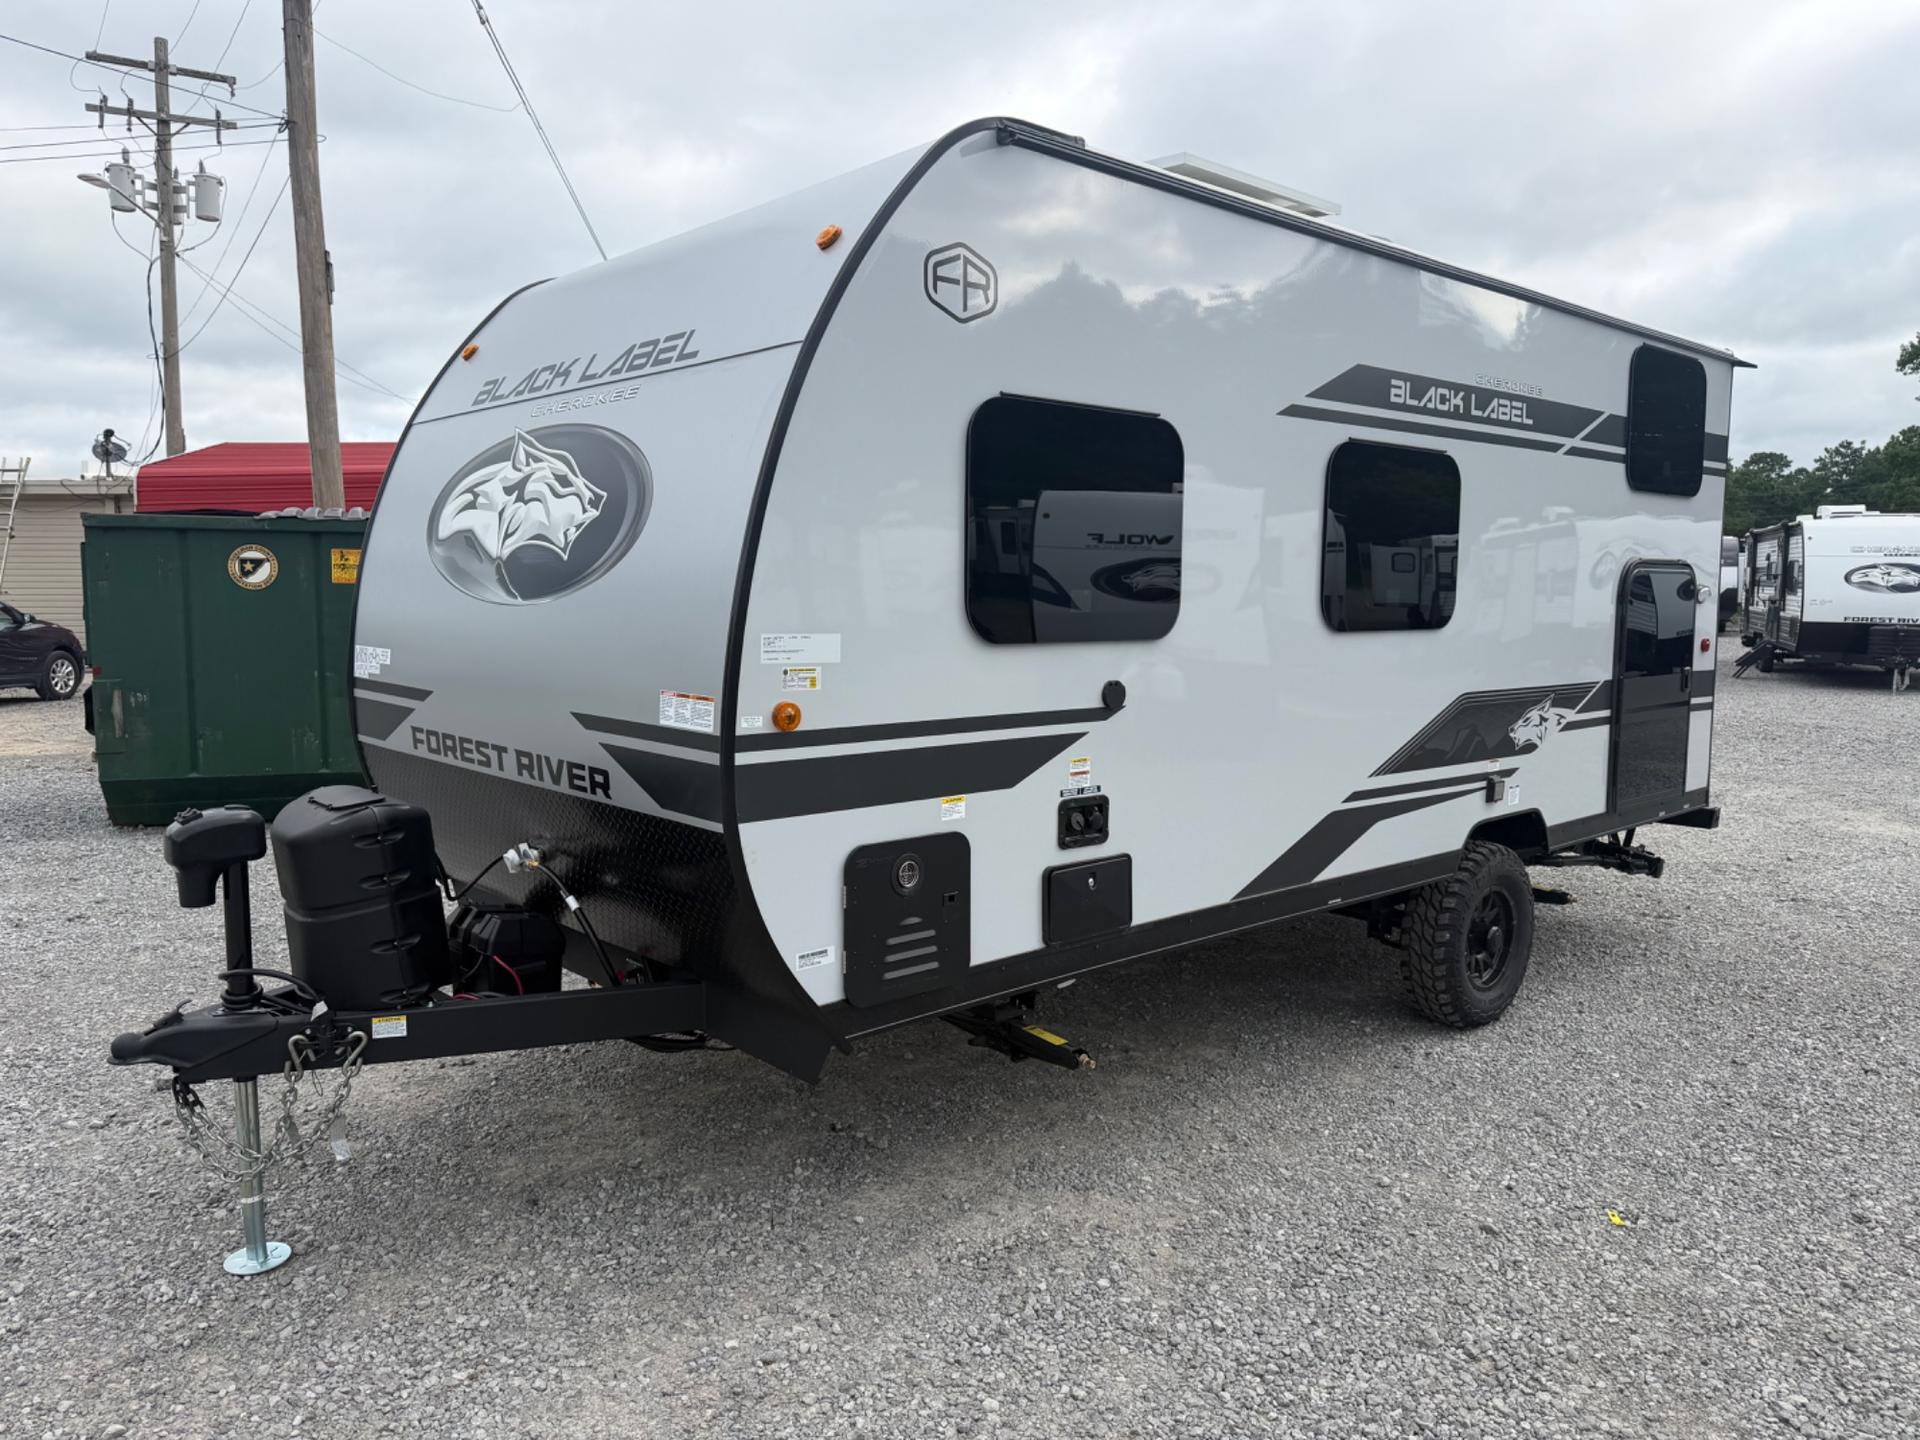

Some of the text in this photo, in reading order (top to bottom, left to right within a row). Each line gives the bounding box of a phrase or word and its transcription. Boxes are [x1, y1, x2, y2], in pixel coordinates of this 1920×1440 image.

[471, 329, 700, 406] BLACK LABEL
[1474, 373, 1543, 397] CHEROKEE
[530, 384, 641, 418] CHEROKEE
[1390, 378, 1533, 424] BLACK LABEL
[410, 725, 612, 800] FOREST RIVER
